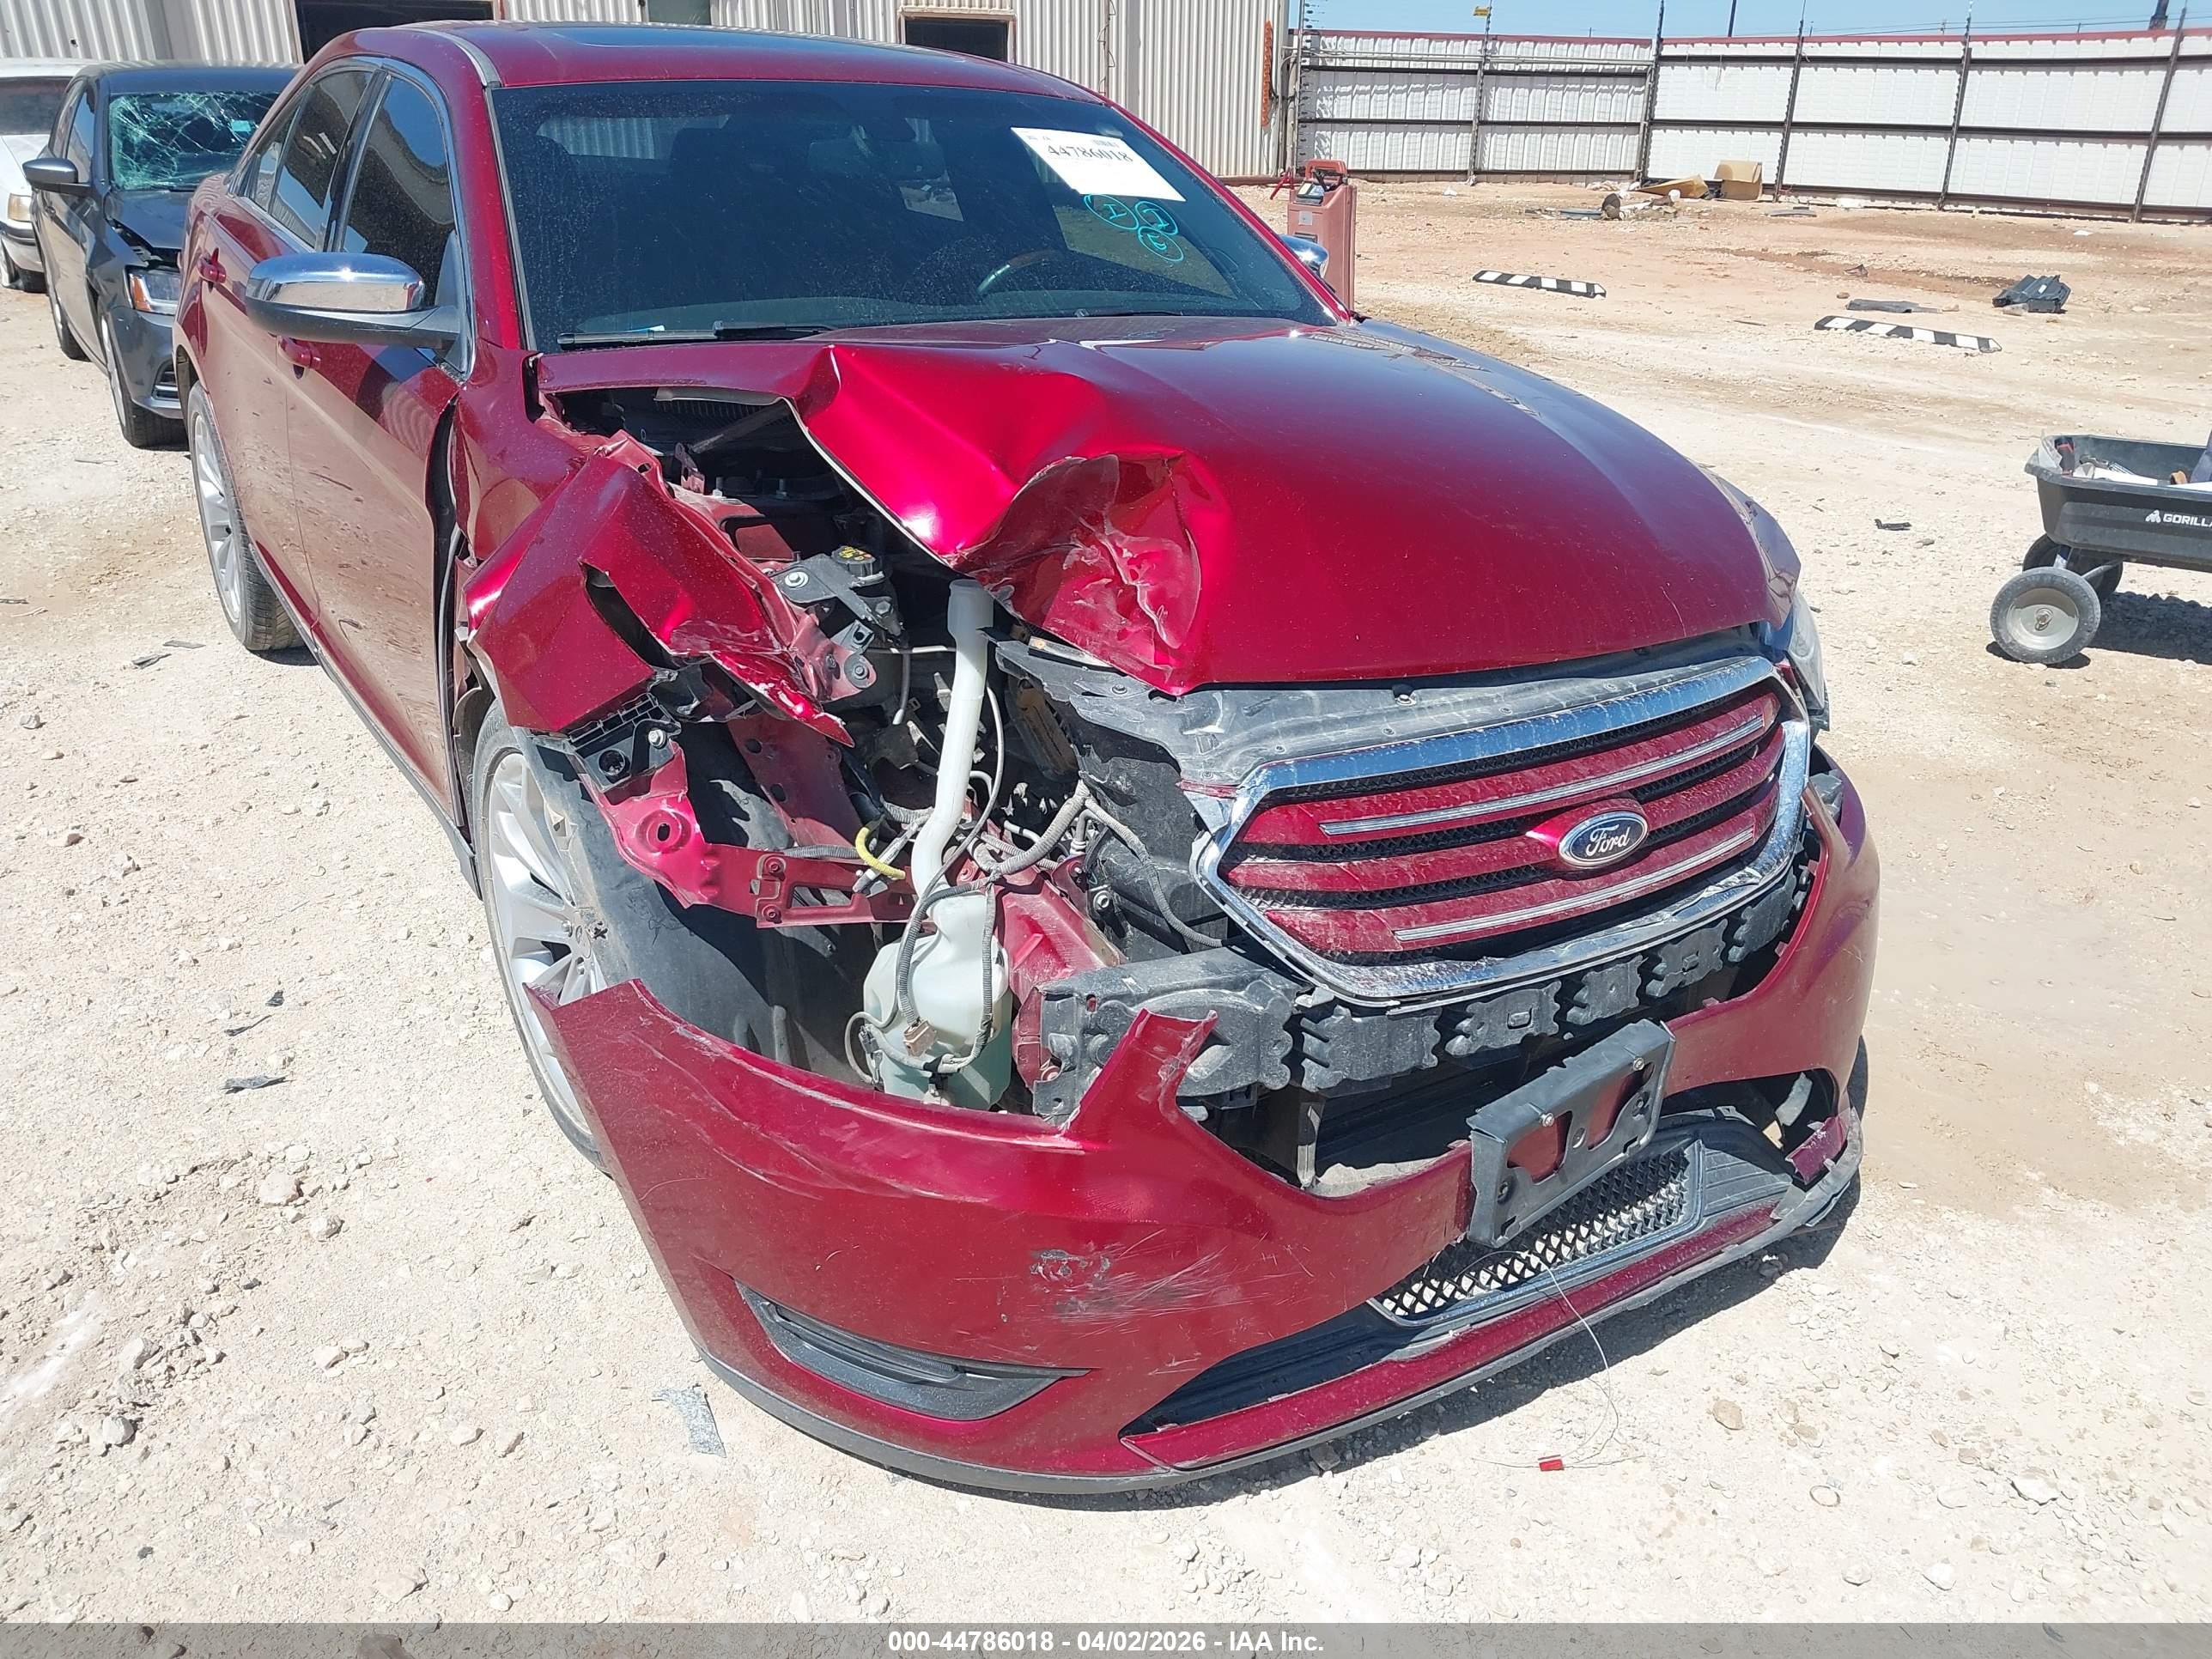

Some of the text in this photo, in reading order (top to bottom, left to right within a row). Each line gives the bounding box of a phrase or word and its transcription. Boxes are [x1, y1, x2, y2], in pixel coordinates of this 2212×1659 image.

[1048, 144, 1133, 162] 44786018
[2162, 513, 2212, 527] GORILL
[1584, 823, 1631, 857] Ford
